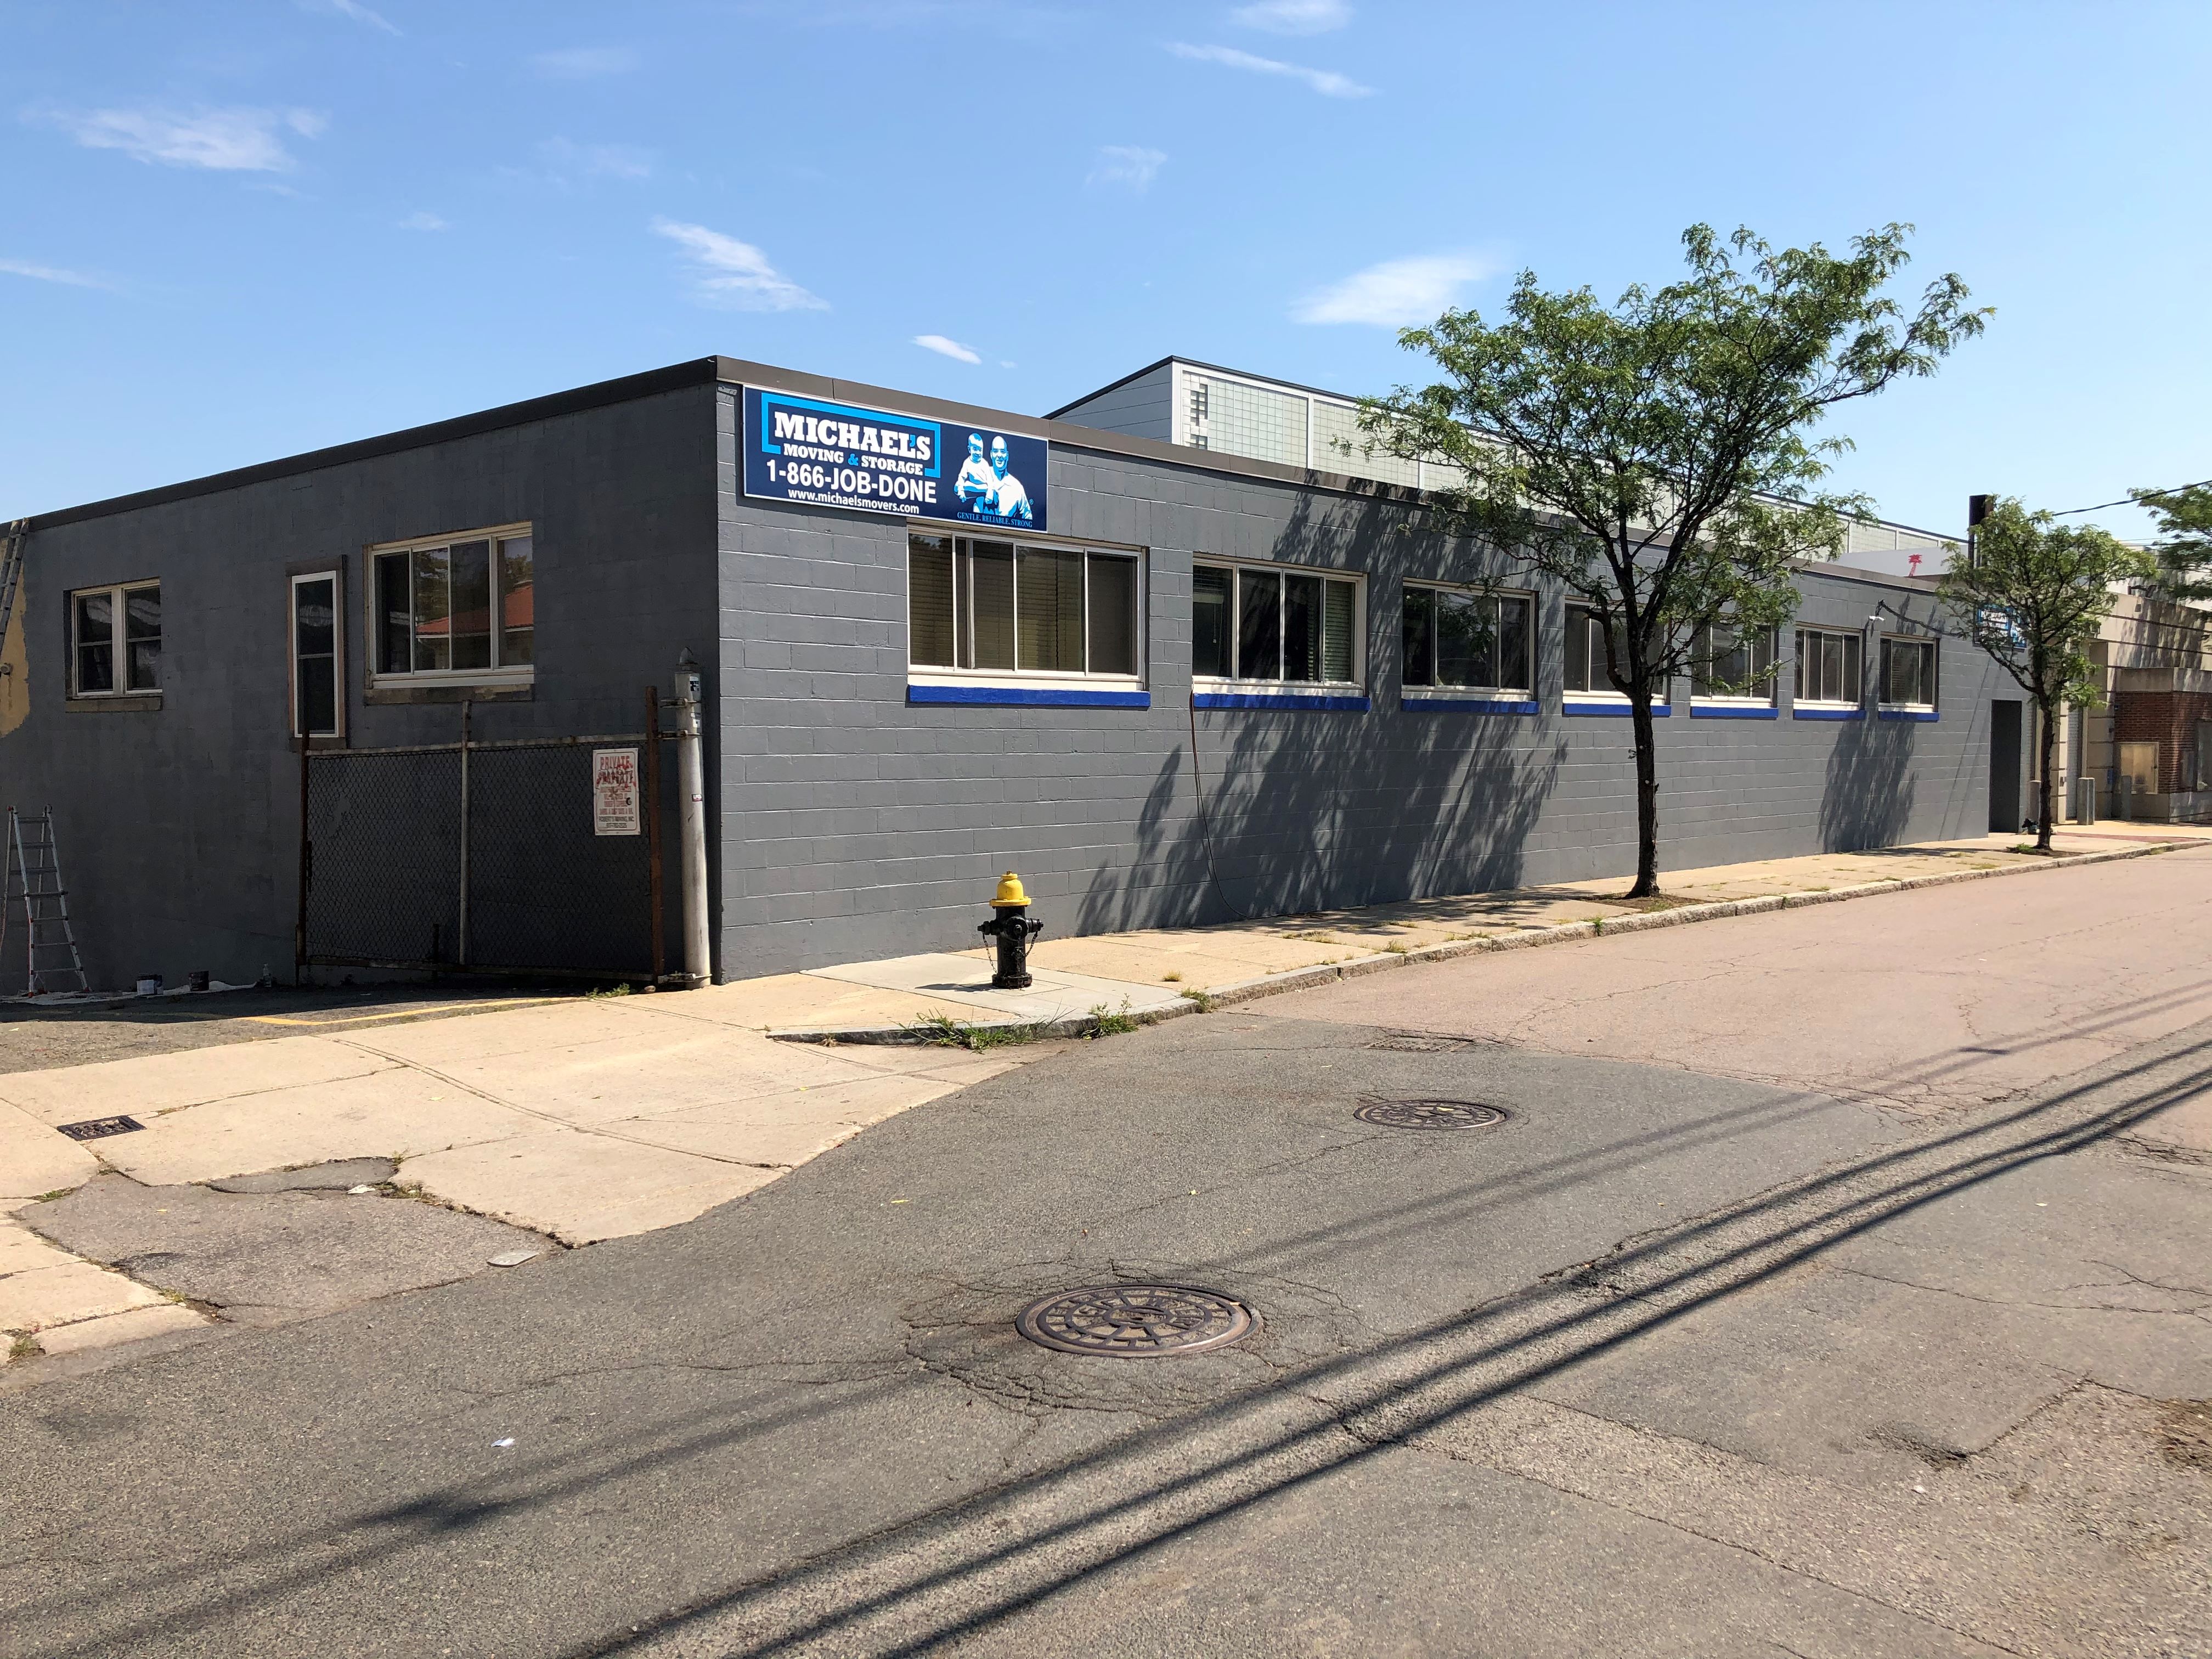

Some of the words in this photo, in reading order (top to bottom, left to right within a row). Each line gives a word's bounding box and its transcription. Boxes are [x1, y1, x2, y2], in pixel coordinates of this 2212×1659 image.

[774, 411, 930, 460] MICHAEL'S
[783, 443, 844, 464] MOVING
[848, 454, 859, 466] &
[861, 455, 923, 475] STORAGE
[766, 459, 936, 504] 1-866-JOB-DONE
[788, 489, 919, 514] www.michaelsmovers.com
[957, 511, 981, 521] GENTLE.
[982, 515, 1011, 525] RELIABLE.
[1011, 518, 1032, 527] STRONG
[600, 755, 630, 770] PRIVATE
